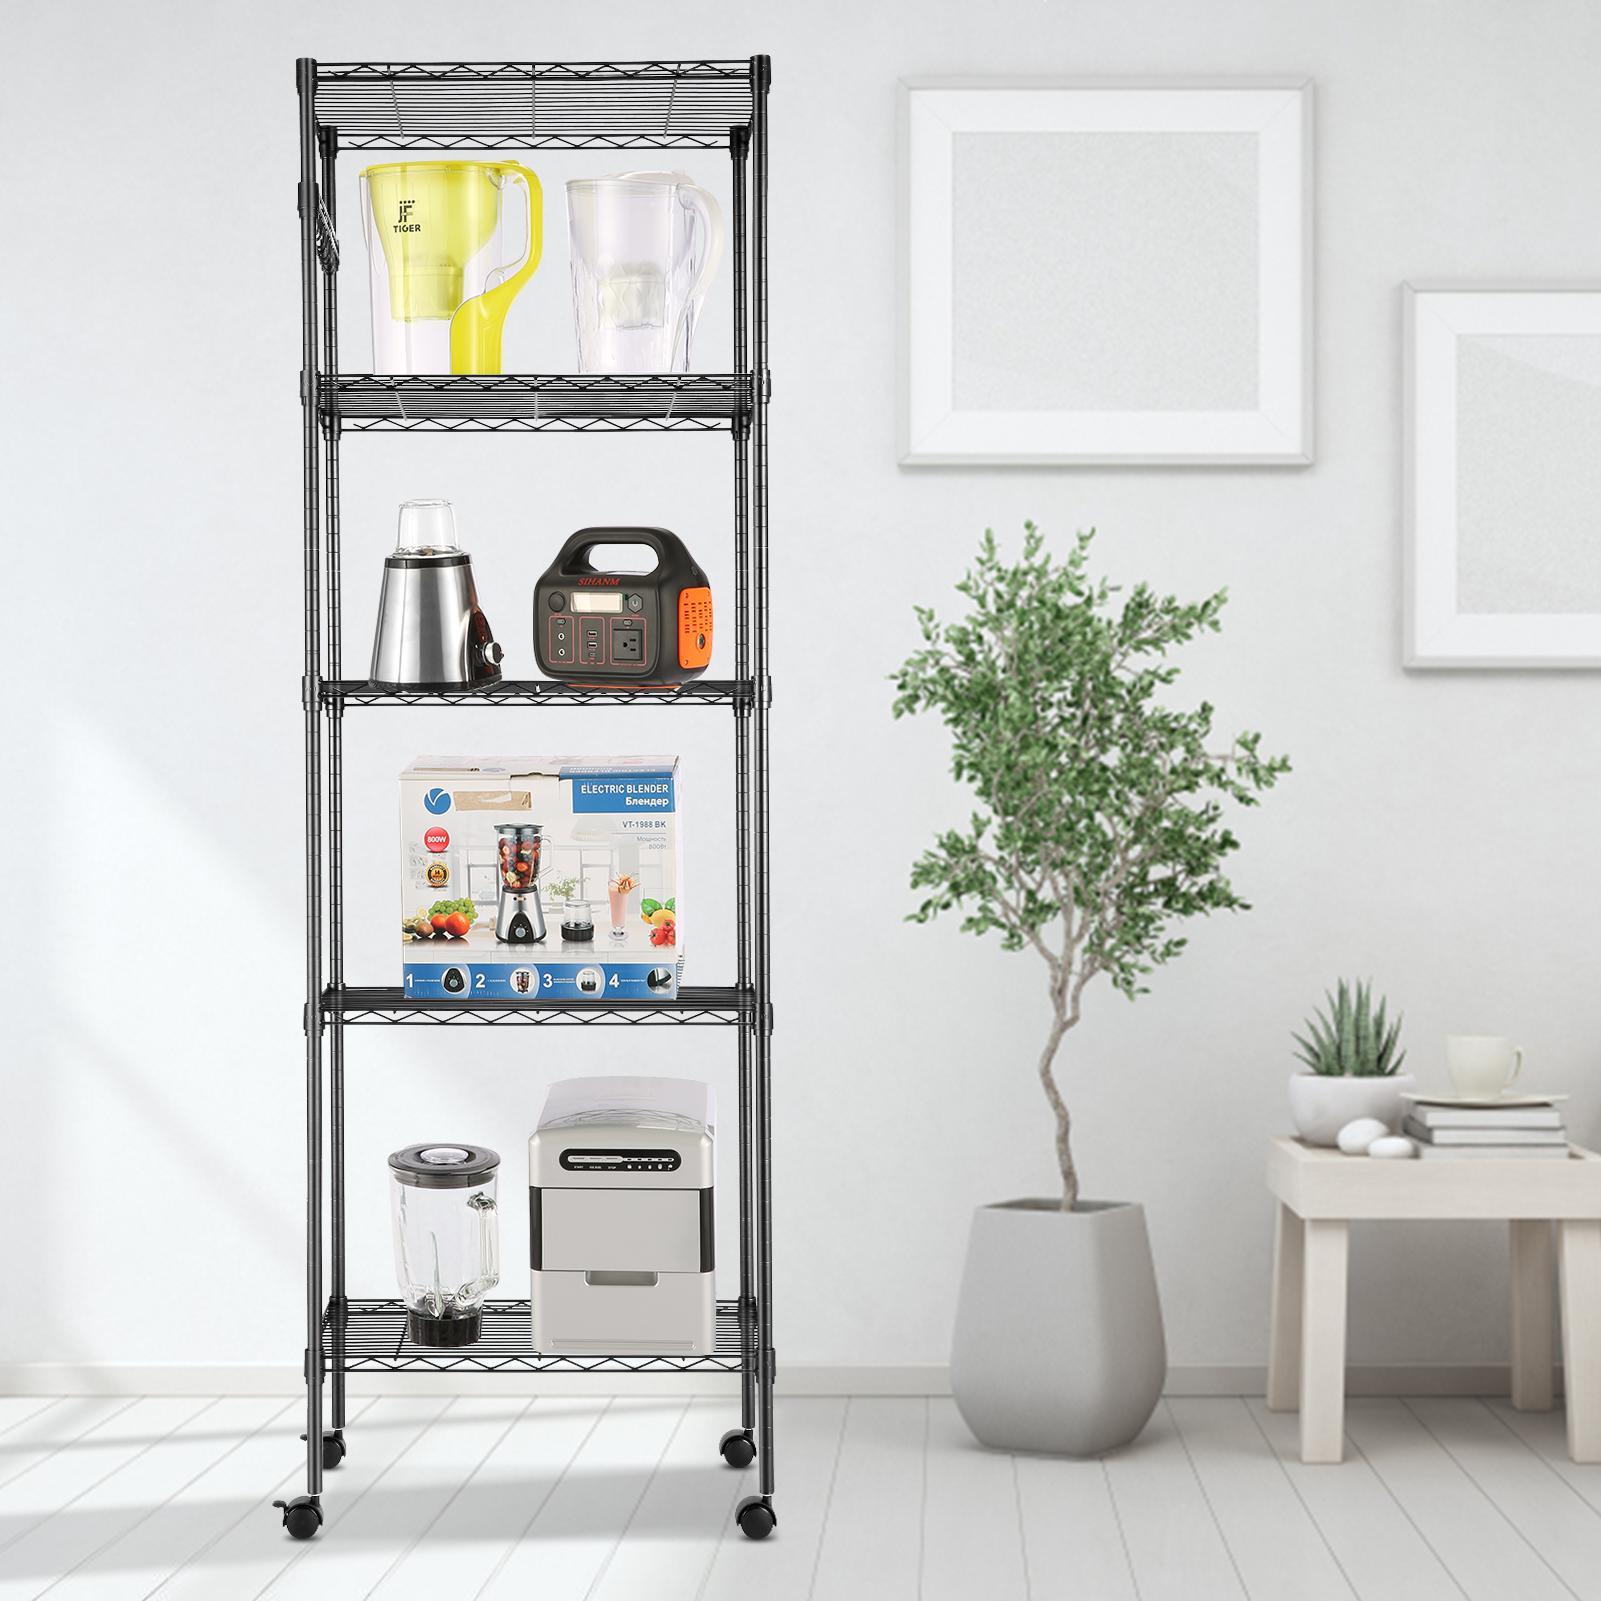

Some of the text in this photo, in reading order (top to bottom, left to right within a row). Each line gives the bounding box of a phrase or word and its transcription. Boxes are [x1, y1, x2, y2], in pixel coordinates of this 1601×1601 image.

[393, 224, 421, 233] TIGER
[577, 578, 621, 586] SIHANM
[581, 784, 669, 794] ELECTRIC BLENDER
[625, 797, 669, 807] Блендер
[406, 974, 413, 988] 1
[475, 974, 486, 988] 2
[543, 973, 553, 988] 3
[608, 973, 620, 988] 4
